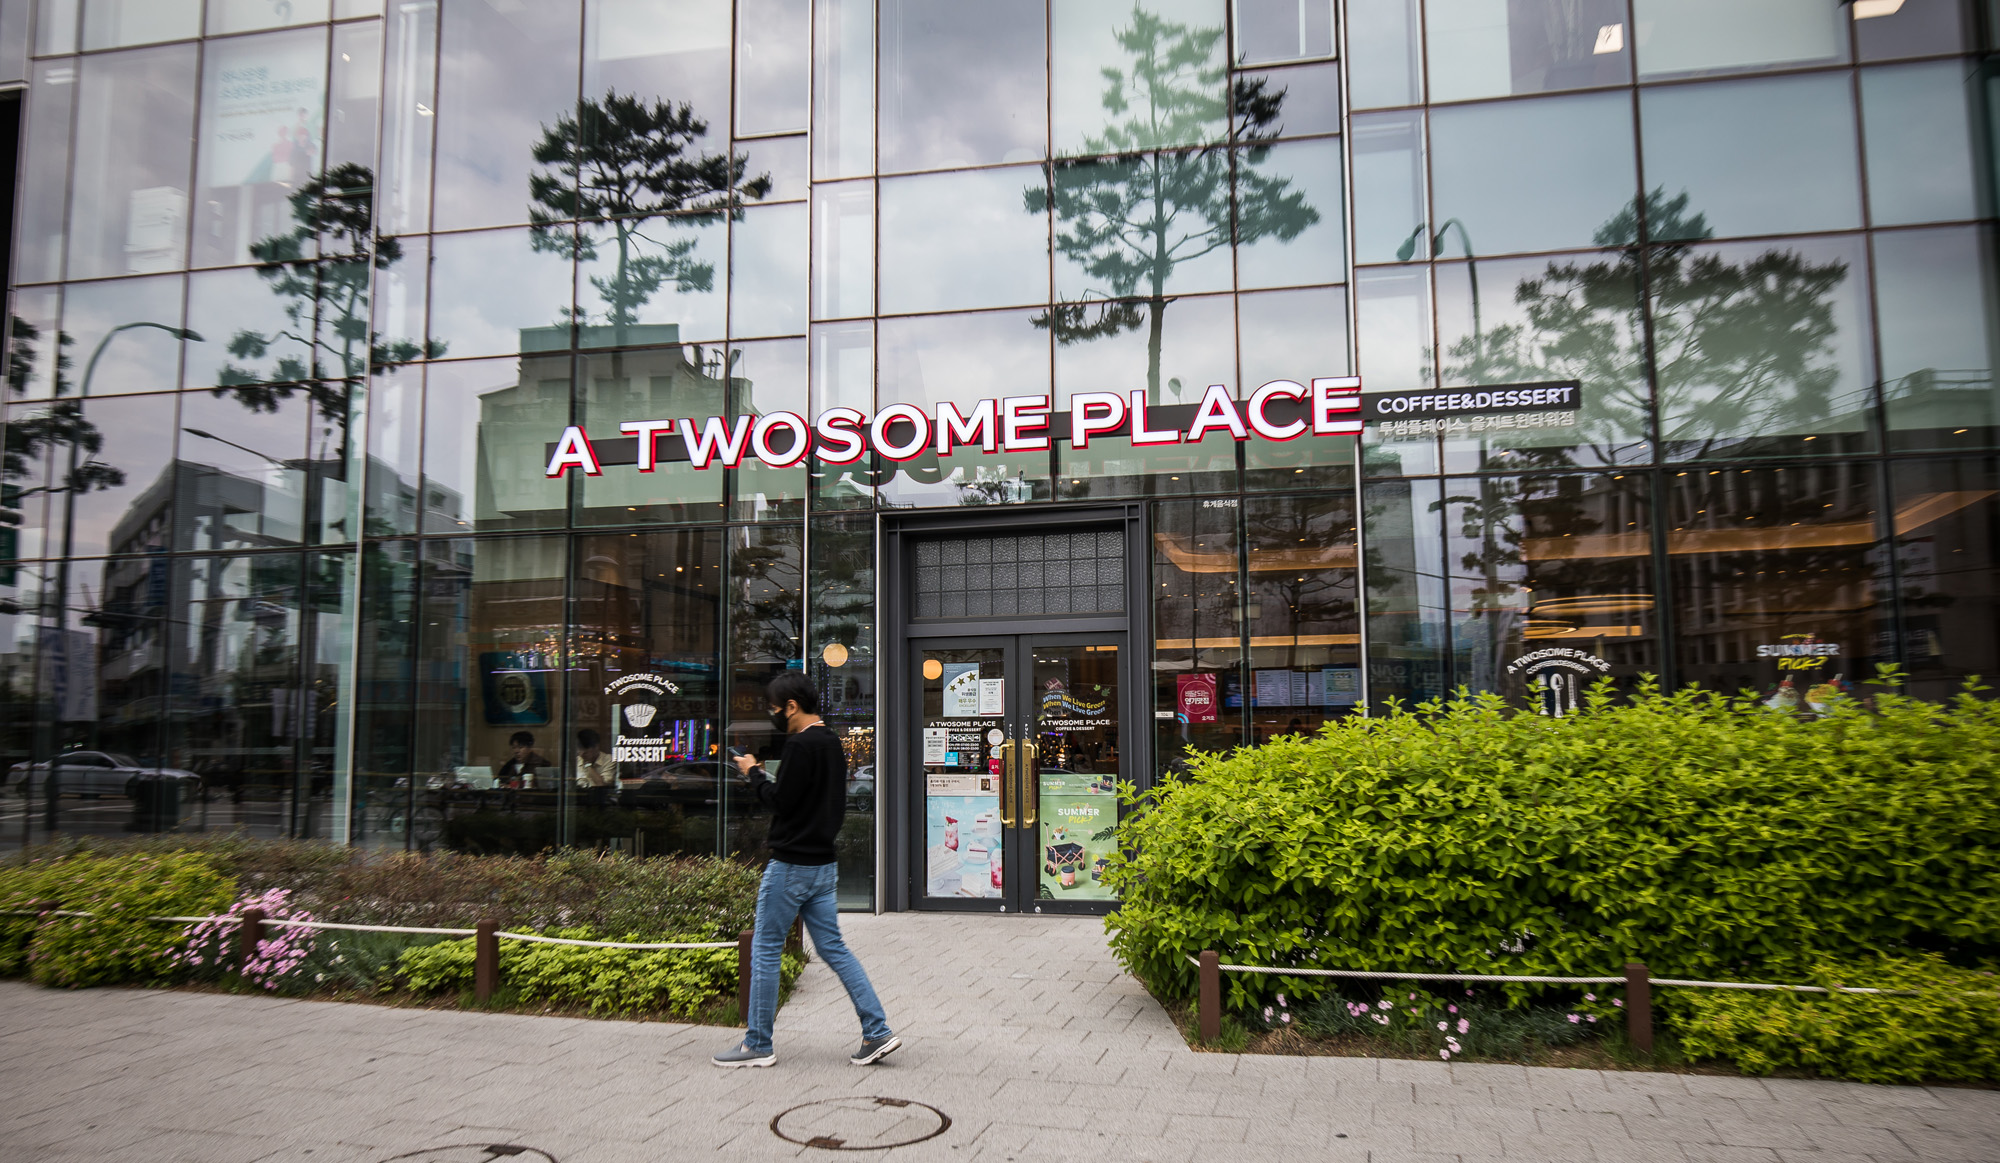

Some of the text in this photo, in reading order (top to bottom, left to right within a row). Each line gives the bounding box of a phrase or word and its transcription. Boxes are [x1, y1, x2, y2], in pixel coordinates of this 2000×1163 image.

[1377, 387, 1575, 414] COFFEE&DESSERT
[545, 375, 1364, 479] A TWOSOME PLACE
[1379, 410, 1576, 437] 투썸플레이스 을지트윈타워점
[1756, 643, 1841, 657] SUMMER
[1507, 647, 1612, 675] A TWOSOME PLACE
[1777, 656, 1829, 670] PICK?
[604, 673, 680, 695] A TWOSOME PLACE
[1042, 694, 1106, 709] When We Live Green
[1042, 701, 1106, 715] When We Live Green
[615, 734, 664, 745] Premium
[616, 746, 667, 762] DESSERT
[1058, 808, 1100, 816] SUMMER
[1068, 815, 1094, 824] PICK?
